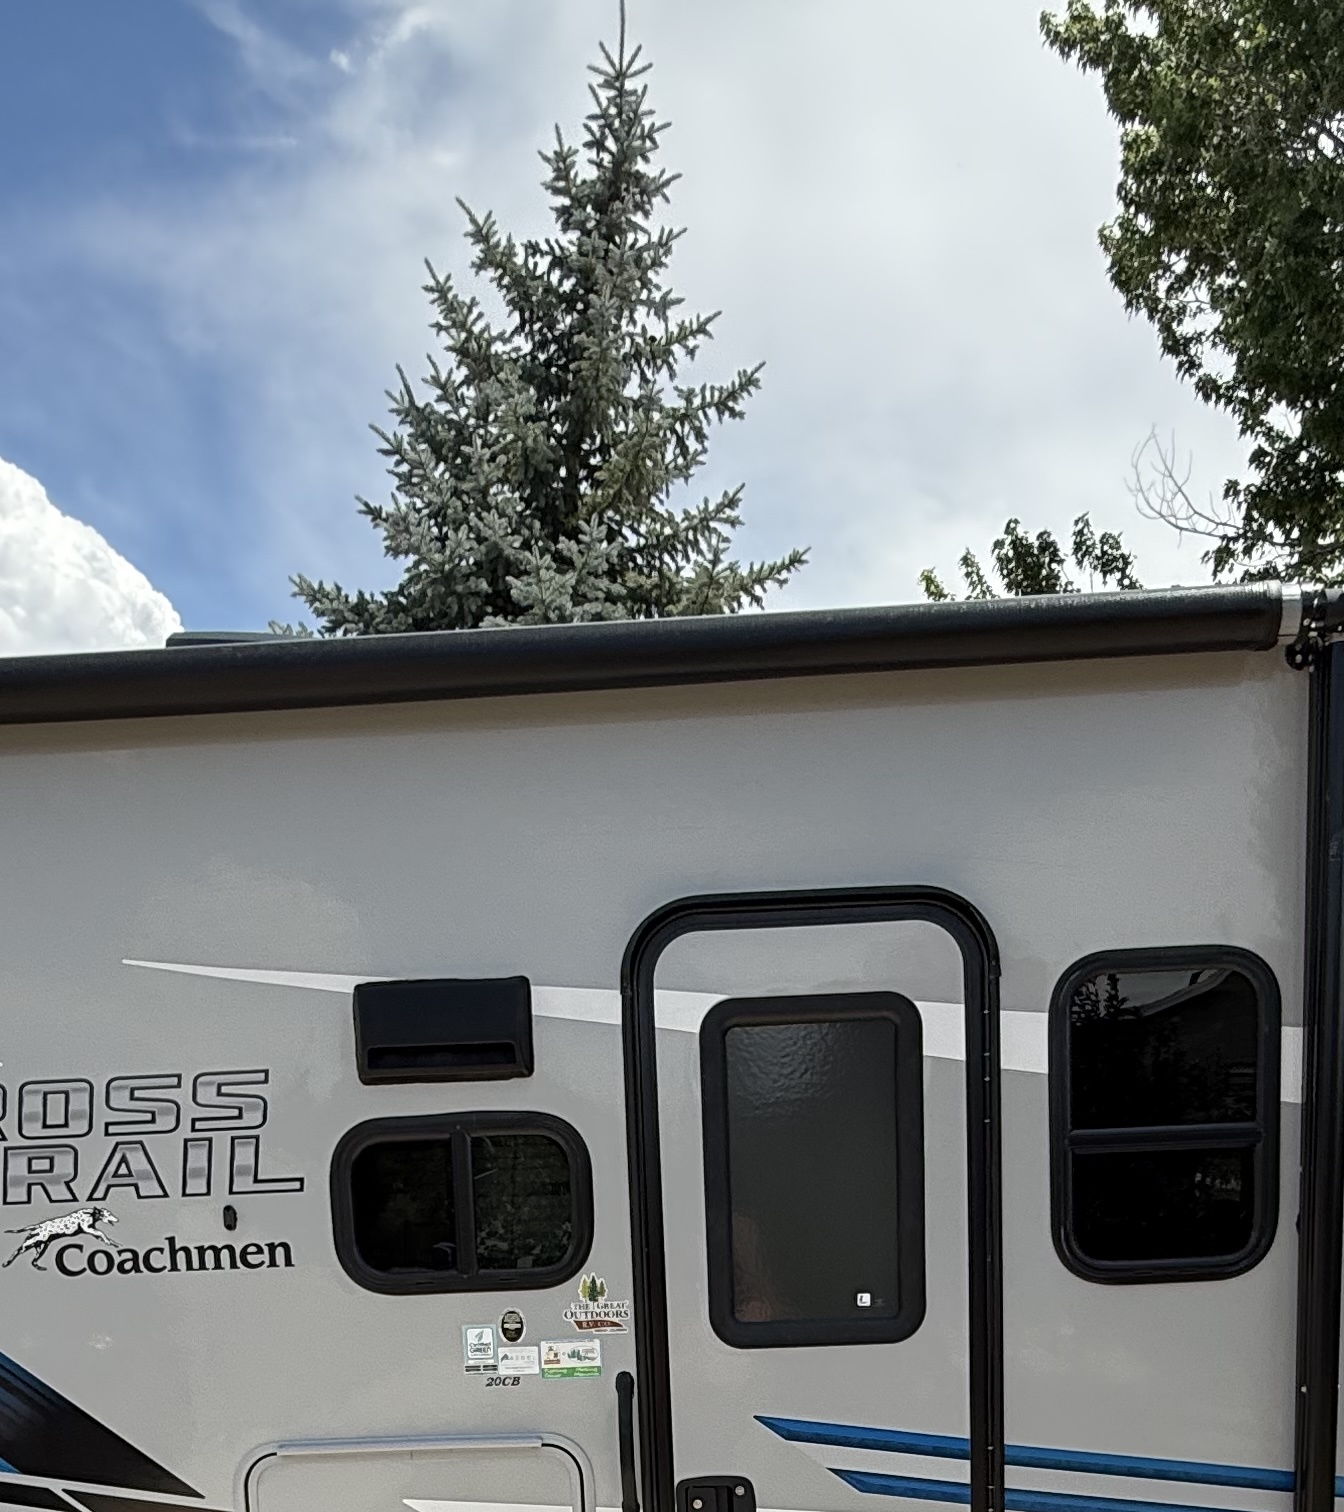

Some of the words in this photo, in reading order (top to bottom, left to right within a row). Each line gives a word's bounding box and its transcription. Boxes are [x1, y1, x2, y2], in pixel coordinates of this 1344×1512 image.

[54, 1236, 295, 1277] Coachmen
[596, 1302, 627, 1310] GREAT
[563, 1309, 629, 1320] OUTDOORS
[485, 1376, 521, 1387] 20CB
